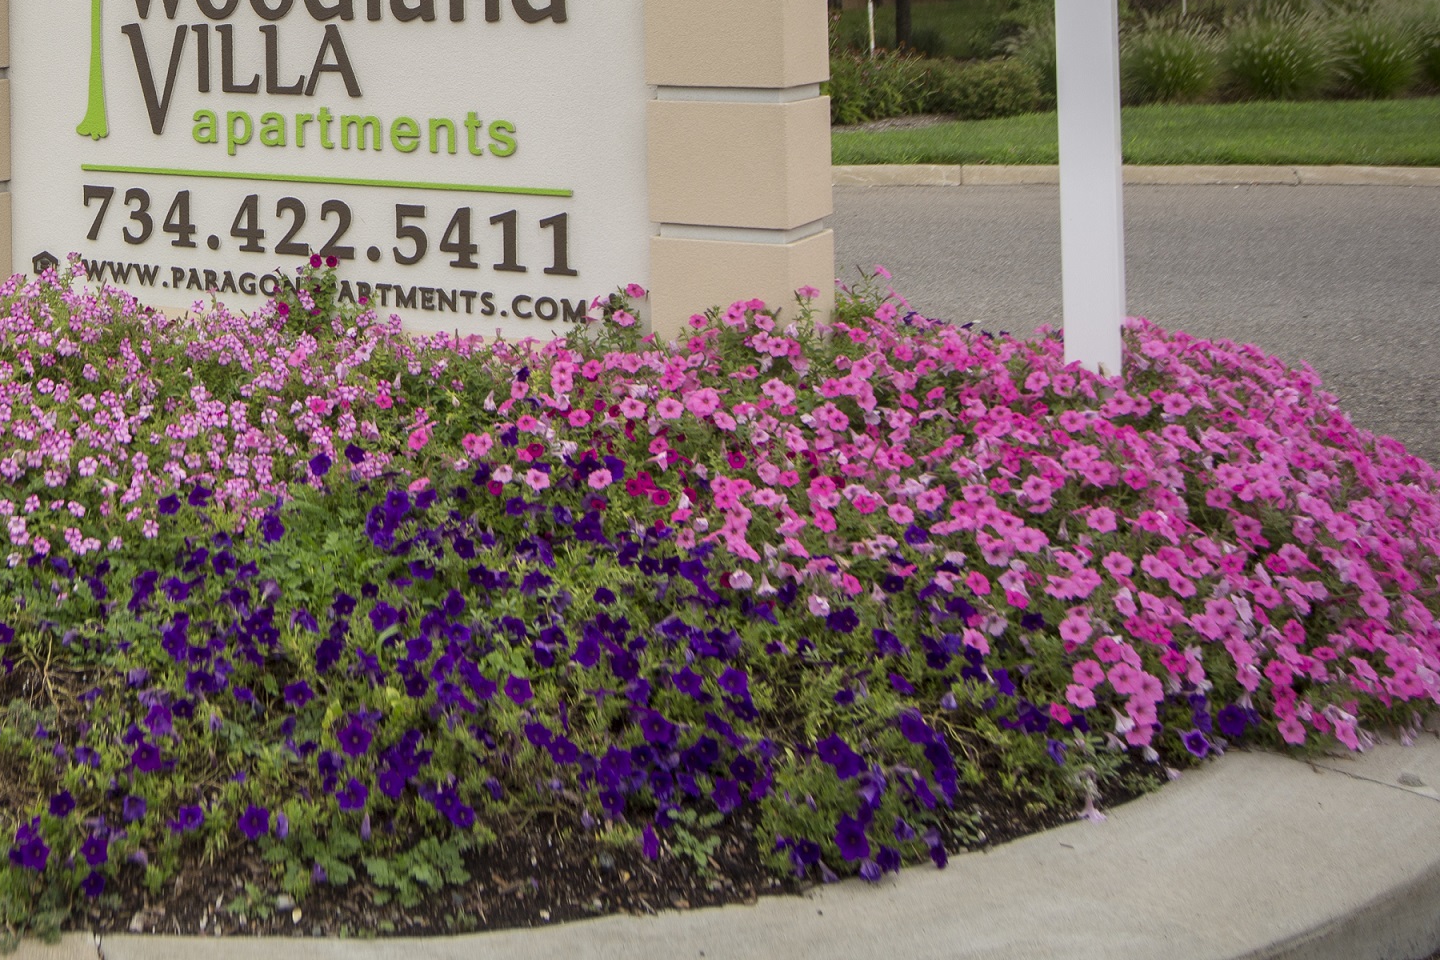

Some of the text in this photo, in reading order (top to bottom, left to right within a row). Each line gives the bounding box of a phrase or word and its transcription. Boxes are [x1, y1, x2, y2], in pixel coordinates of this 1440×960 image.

[121, 22, 361, 135] VILLA
[192, 106, 517, 156] apartments
[82, 184, 578, 276] 734.422.5411
[81, 258, 587, 324] WWW.PARAGONARTMENTS.COM
